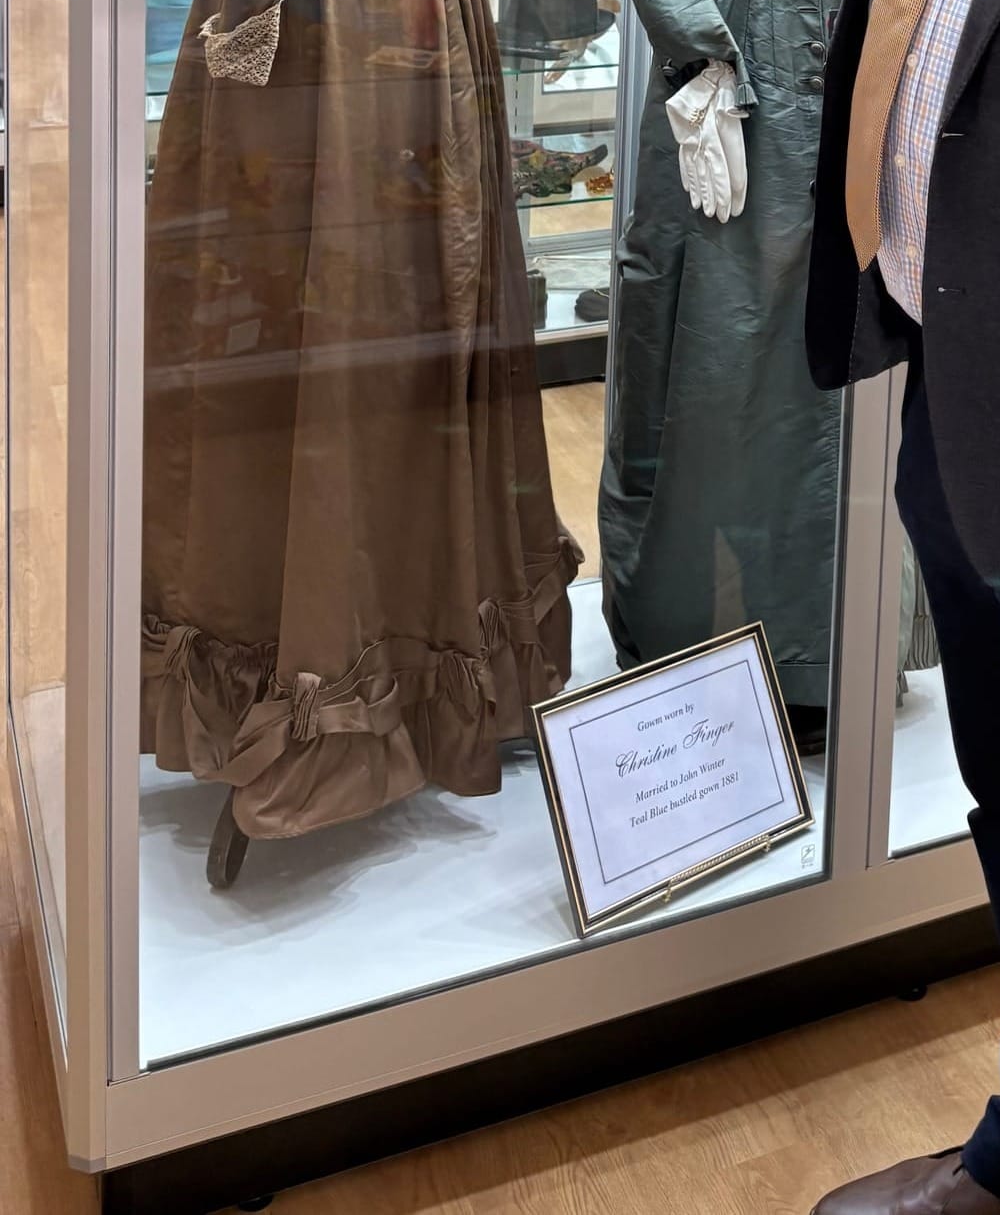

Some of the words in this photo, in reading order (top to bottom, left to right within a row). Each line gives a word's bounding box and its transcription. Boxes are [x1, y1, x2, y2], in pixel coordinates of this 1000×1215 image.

[665, 707, 684, 722] worn
[685, 703, 695, 715] by
[615, 744, 678, 778] Christine
[682, 718, 735, 749] Finger
[629, 811, 648, 828] Teal
[649, 805, 668, 819] Blue
[670, 789, 697, 810] bustled
[698, 782, 719, 799] gown
[721, 771, 739, 787] 1881
[635, 780, 668, 803] Married
[670, 779, 678, 788] to
[679, 769, 698, 785] John
[699, 758, 725, 774] Winter
